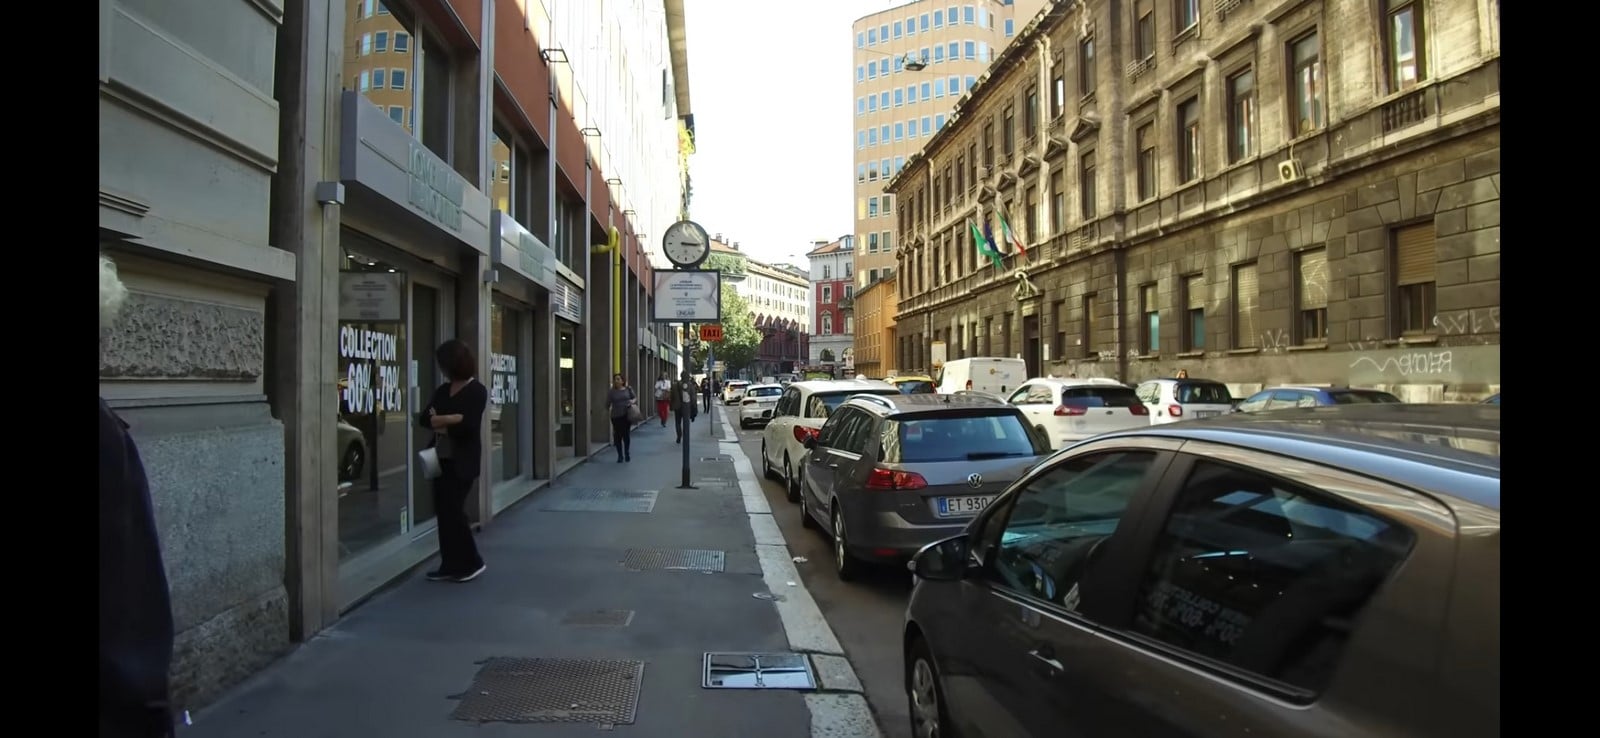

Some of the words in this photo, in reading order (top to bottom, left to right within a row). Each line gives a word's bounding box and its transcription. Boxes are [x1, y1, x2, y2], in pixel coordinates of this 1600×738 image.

[340, 326, 397, 362] COLLECTION
[703, 329, 720, 338] TAXI
[343, 362, 374, 414] -60%
[376, 365, 402, 412] -70%
[948, 498, 962, 512] ET
[966, 497, 989, 511] 930
